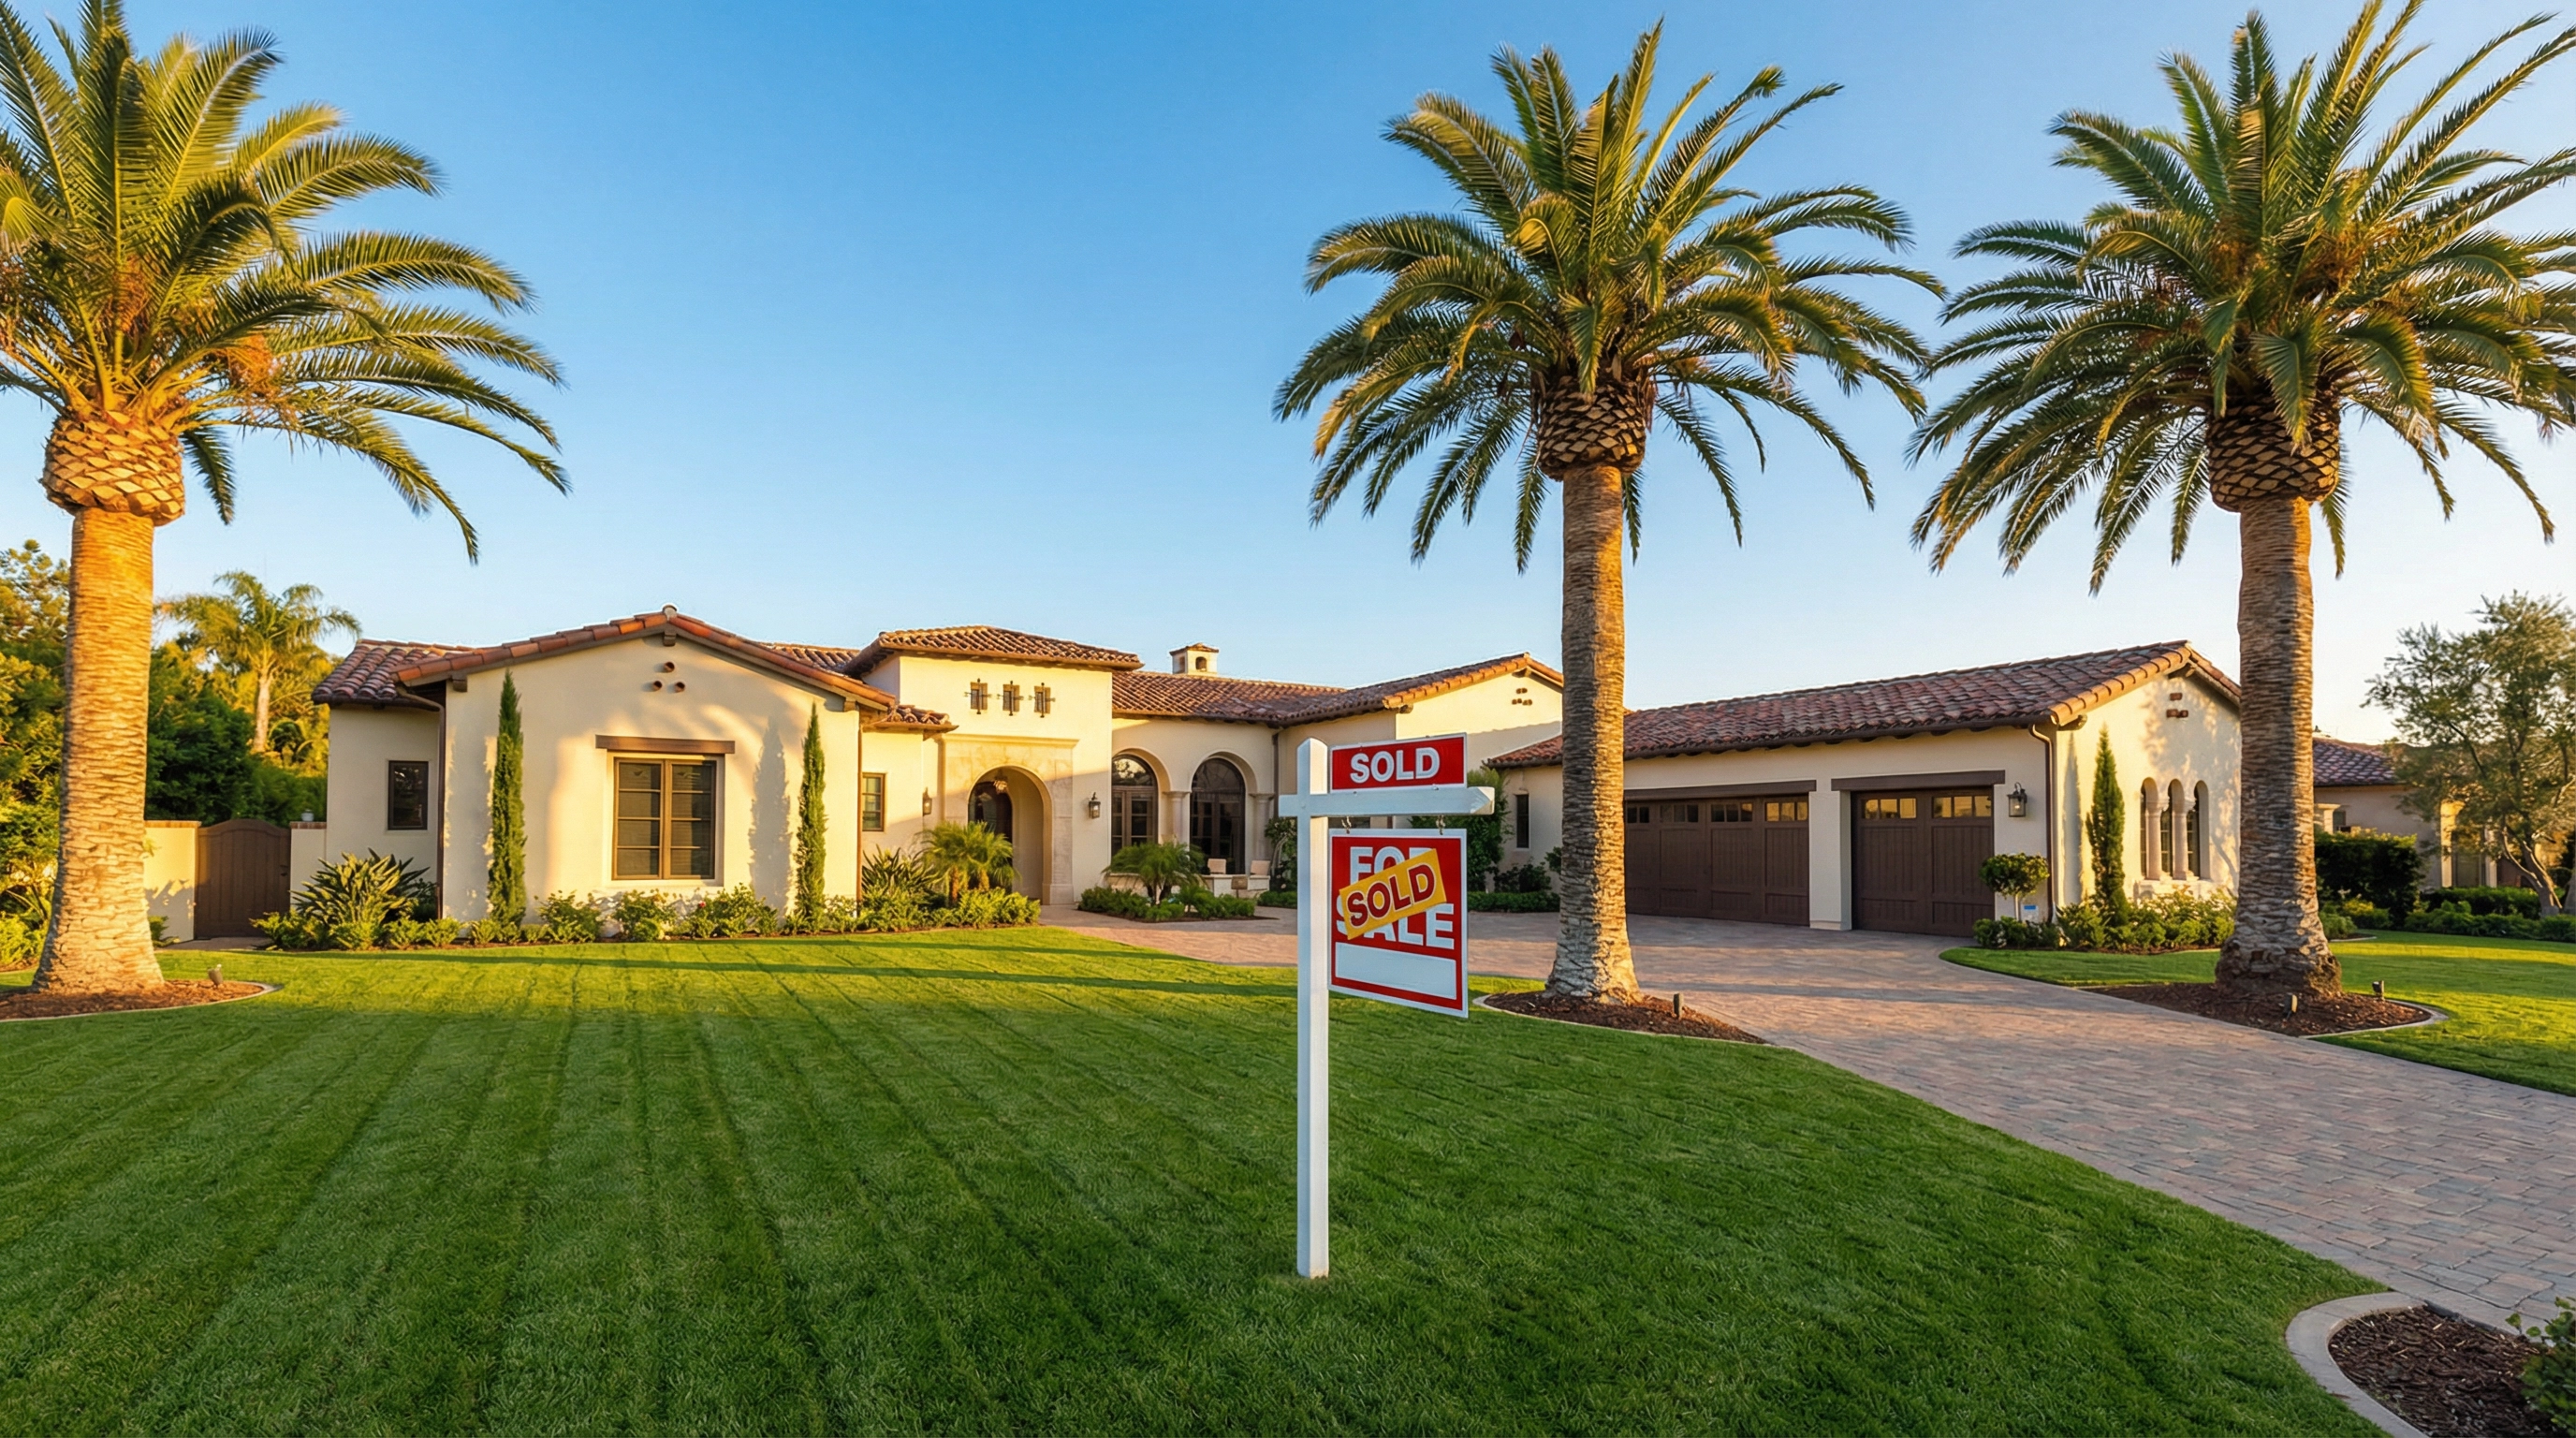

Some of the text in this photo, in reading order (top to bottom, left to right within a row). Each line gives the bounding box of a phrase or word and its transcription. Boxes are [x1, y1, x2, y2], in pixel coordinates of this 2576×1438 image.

[1350, 747, 1440, 784] SOLD
[1350, 845, 1433, 886] FO
[1346, 863, 1436, 929] SOLD
[1336, 895, 1454, 949] LE
